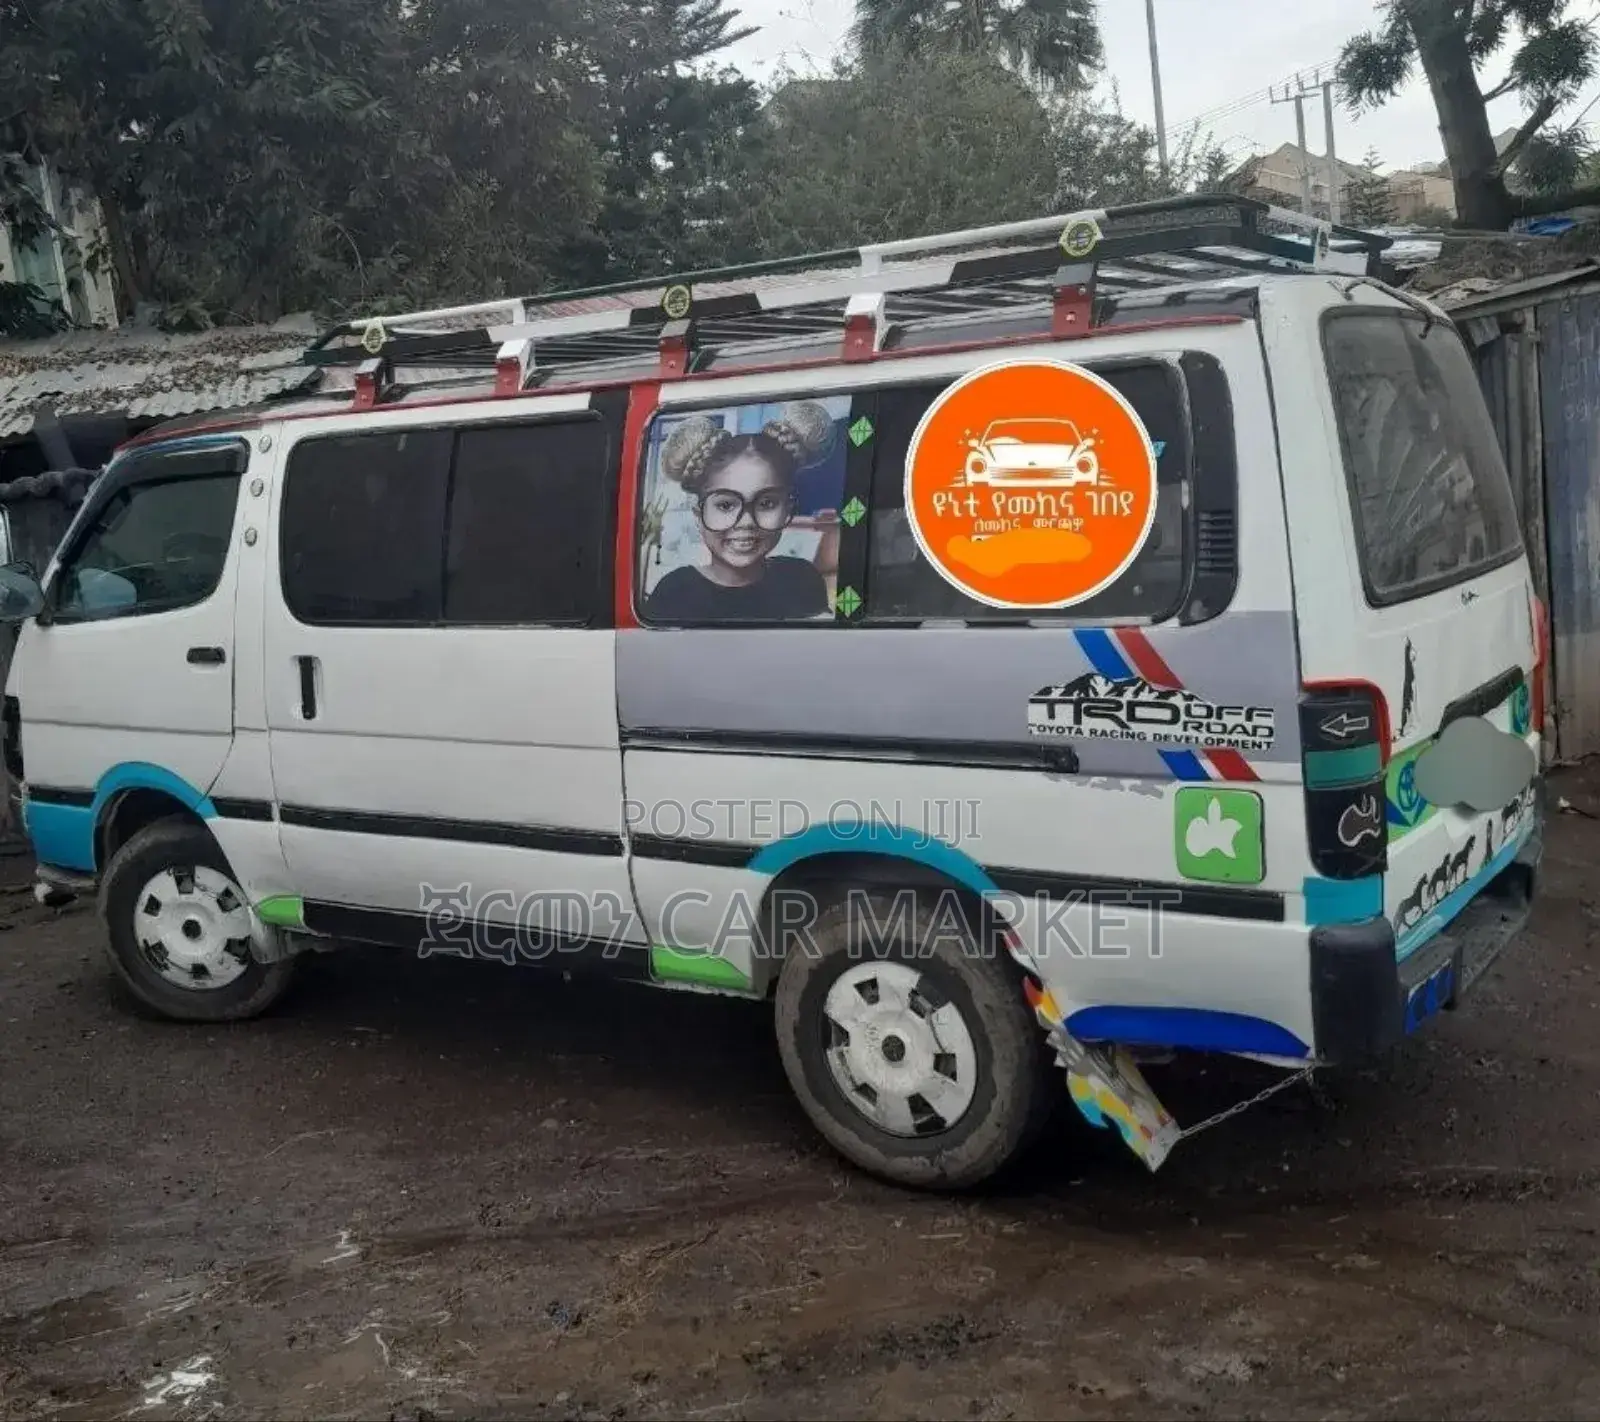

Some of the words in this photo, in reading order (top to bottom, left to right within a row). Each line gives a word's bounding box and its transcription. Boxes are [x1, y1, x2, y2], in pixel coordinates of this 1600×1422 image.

[1029, 697, 1181, 730] TRD
[1184, 704, 1275, 722] OFF
[1089, 727, 1147, 741] RACING
[1152, 732, 1274, 750] DEVELOPMENT
[1182, 720, 1275, 738] ROAD
